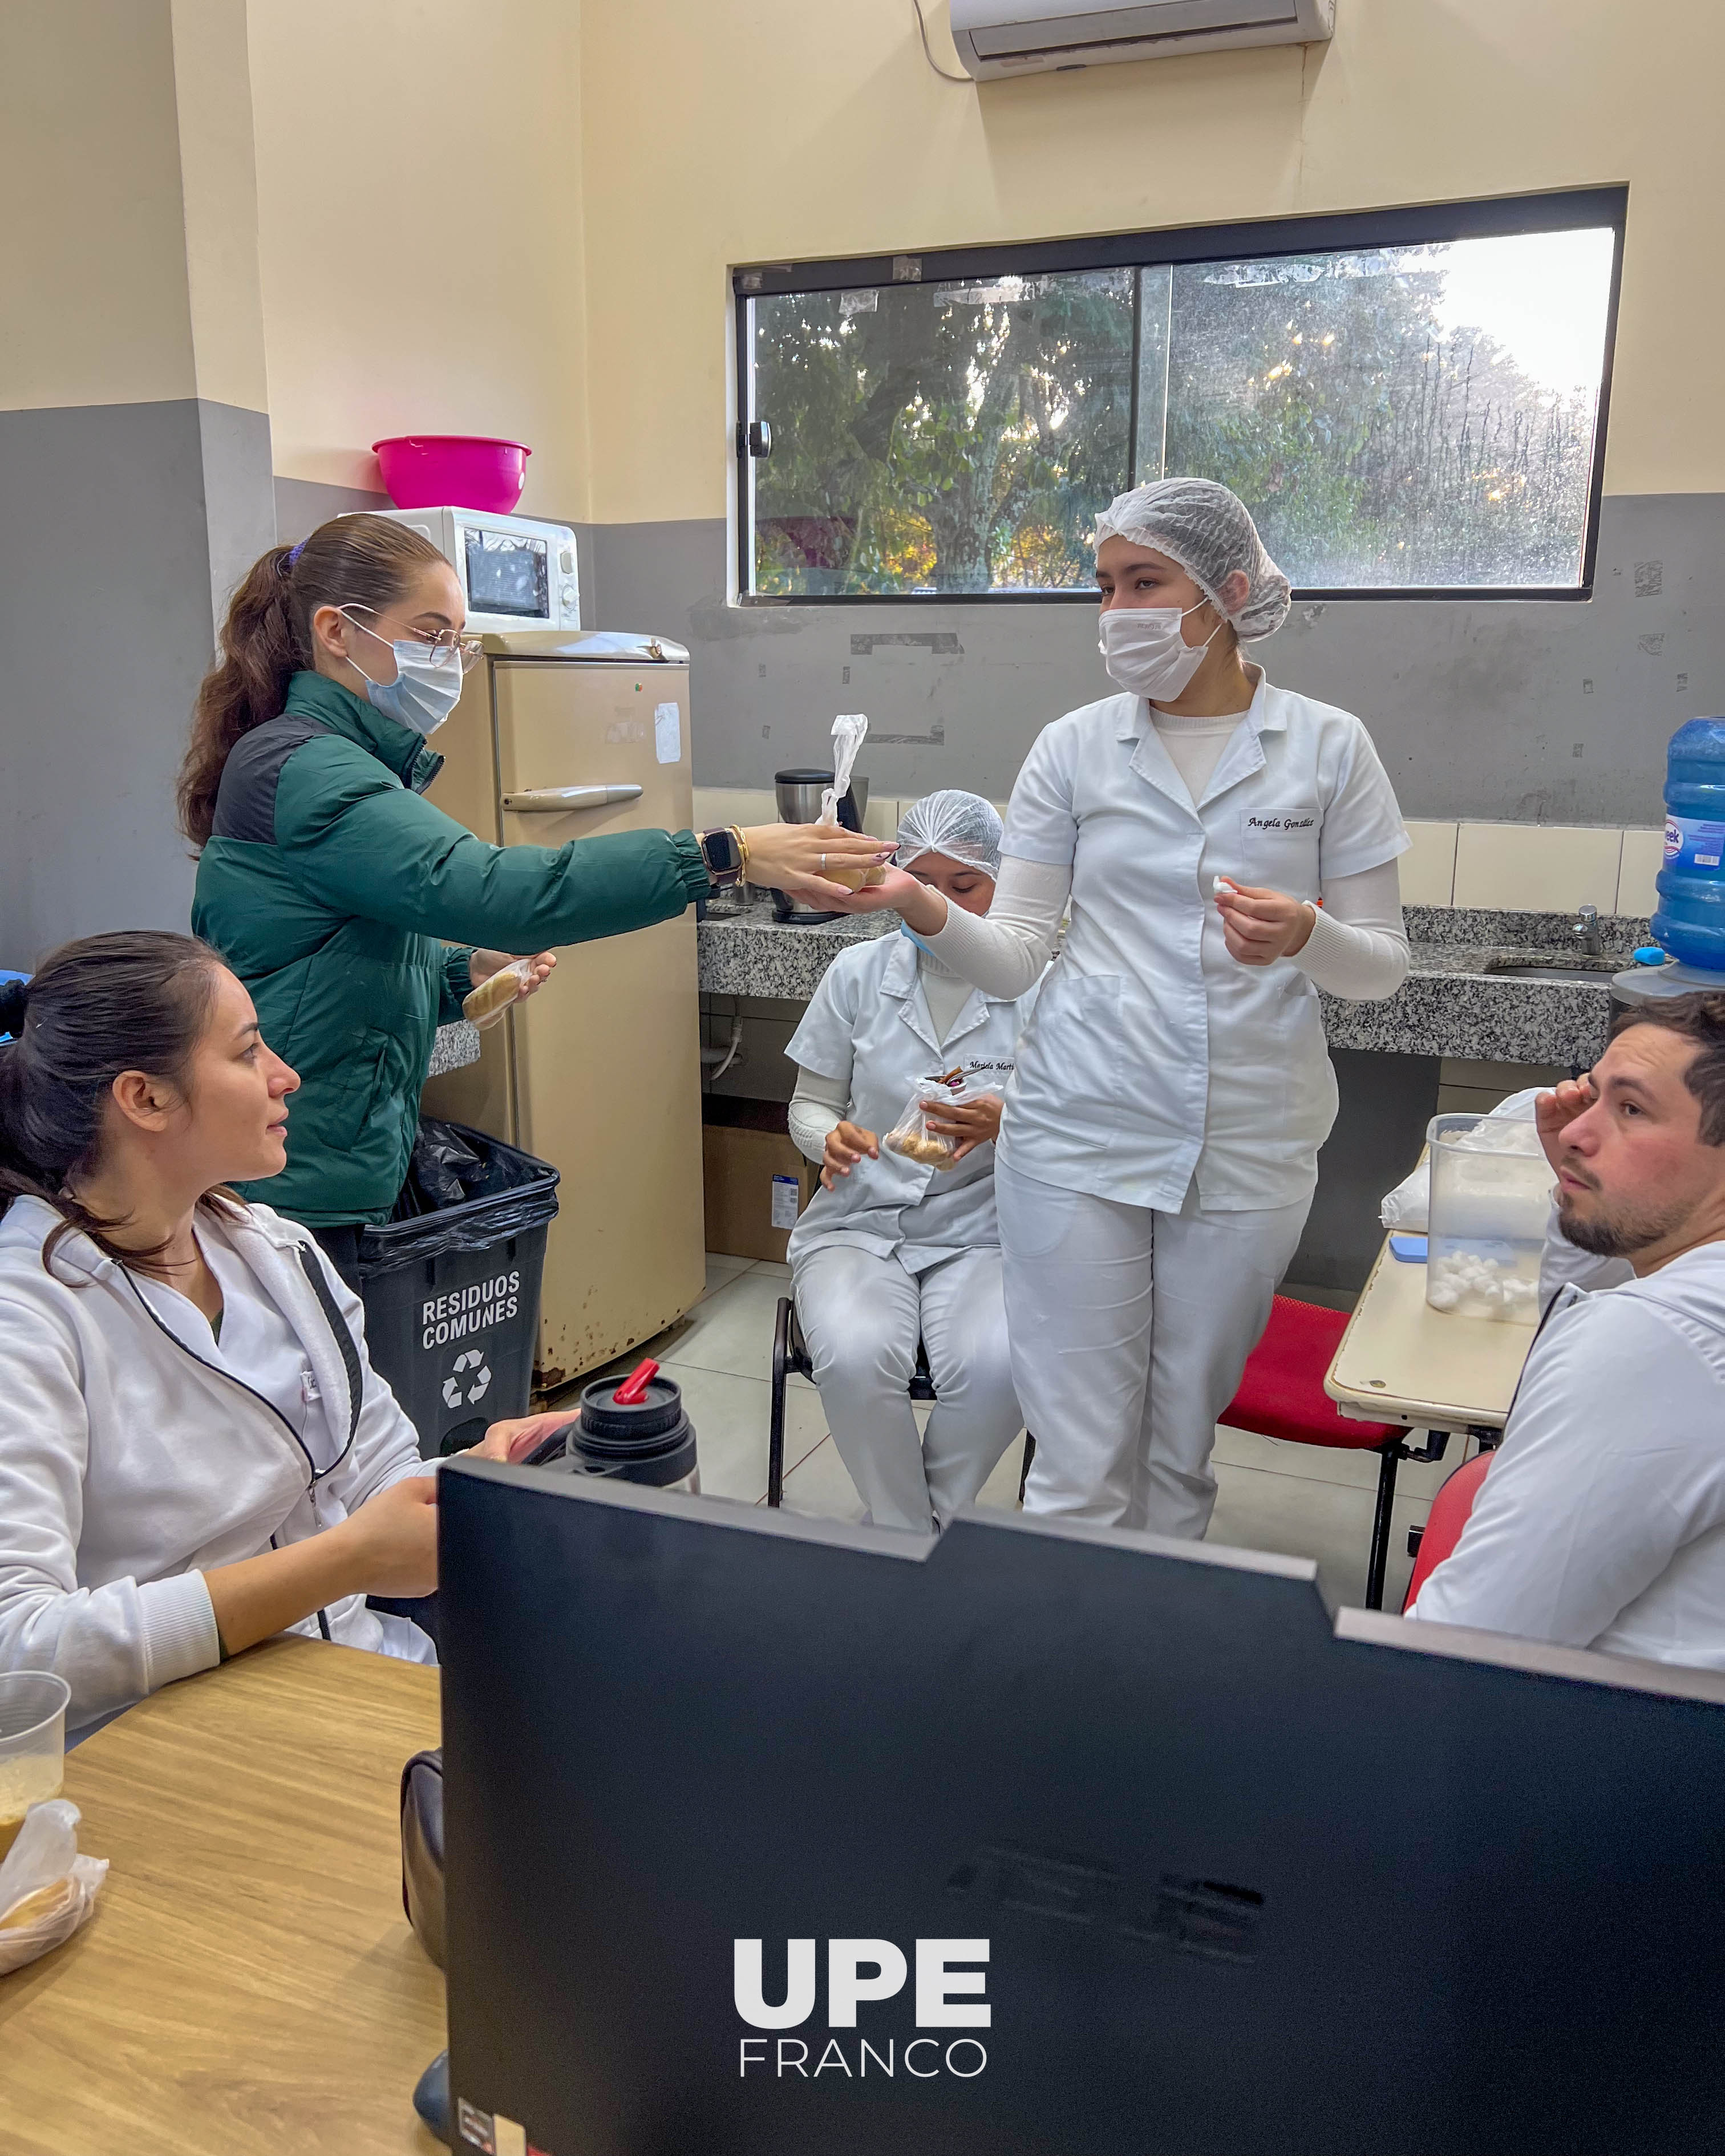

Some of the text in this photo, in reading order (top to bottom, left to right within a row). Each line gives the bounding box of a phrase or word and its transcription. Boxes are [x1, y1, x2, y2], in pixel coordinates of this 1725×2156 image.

[1248, 817, 1281, 830] Angela
[970, 1061, 994, 1069] Mariela
[423, 1271, 520, 1325] RESIDUOS
[423, 1296, 518, 1349] COMUNES
